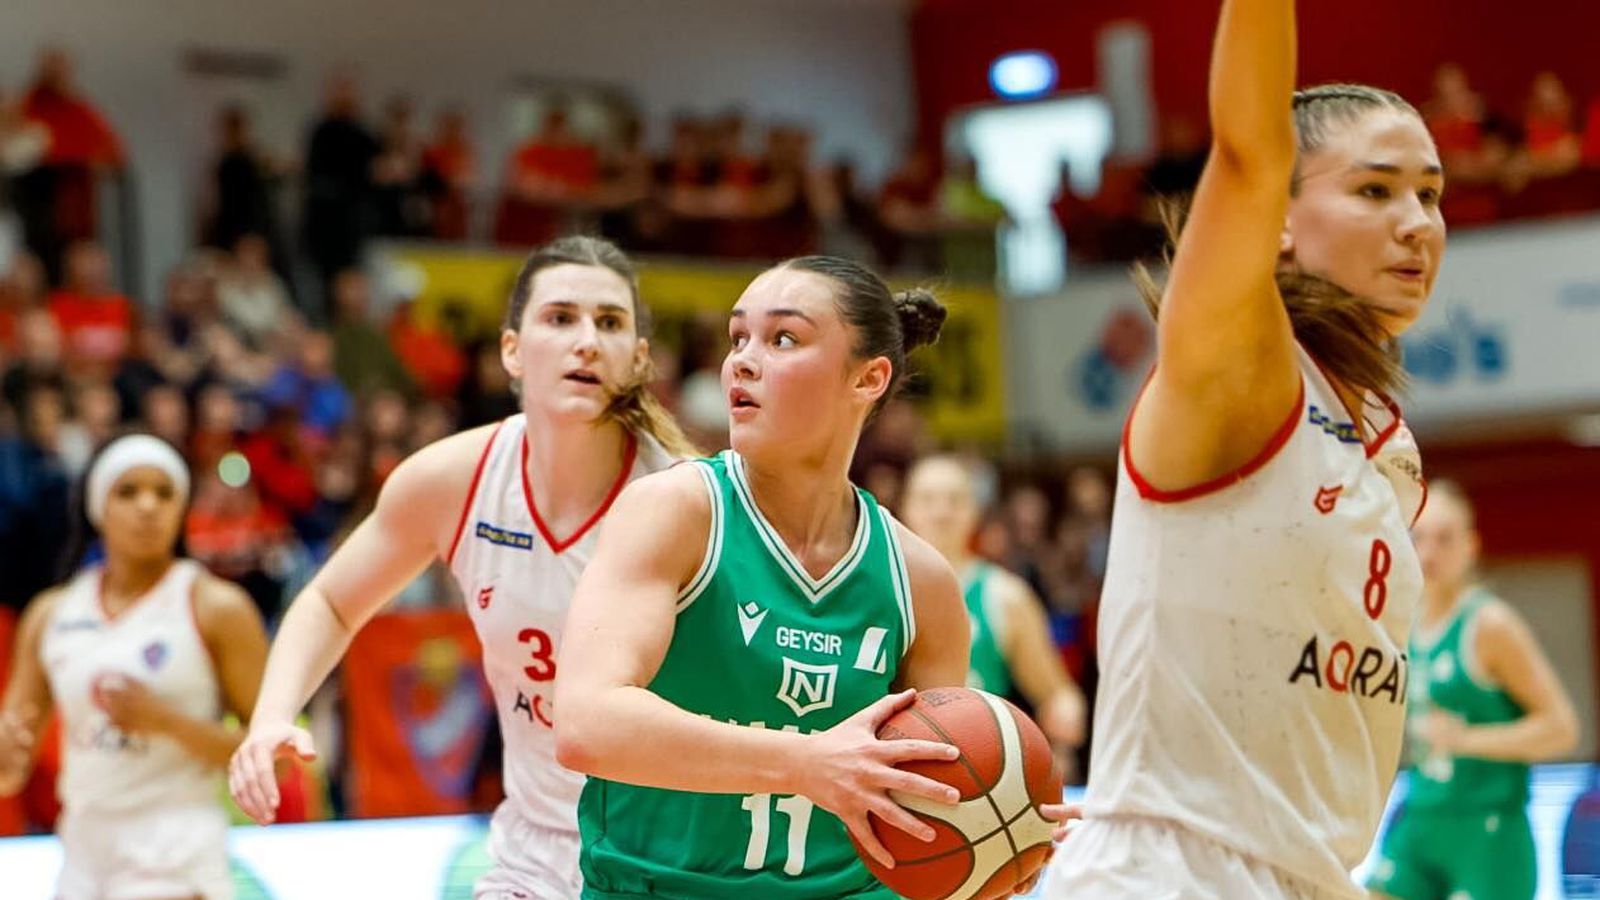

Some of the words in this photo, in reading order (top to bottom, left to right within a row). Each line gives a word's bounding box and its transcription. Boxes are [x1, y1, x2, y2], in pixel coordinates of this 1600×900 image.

[1364, 538, 1391, 620] 8
[518, 628, 556, 682] 3
[776, 626, 842, 656] GEYSIR
[741, 792, 814, 876] 11
